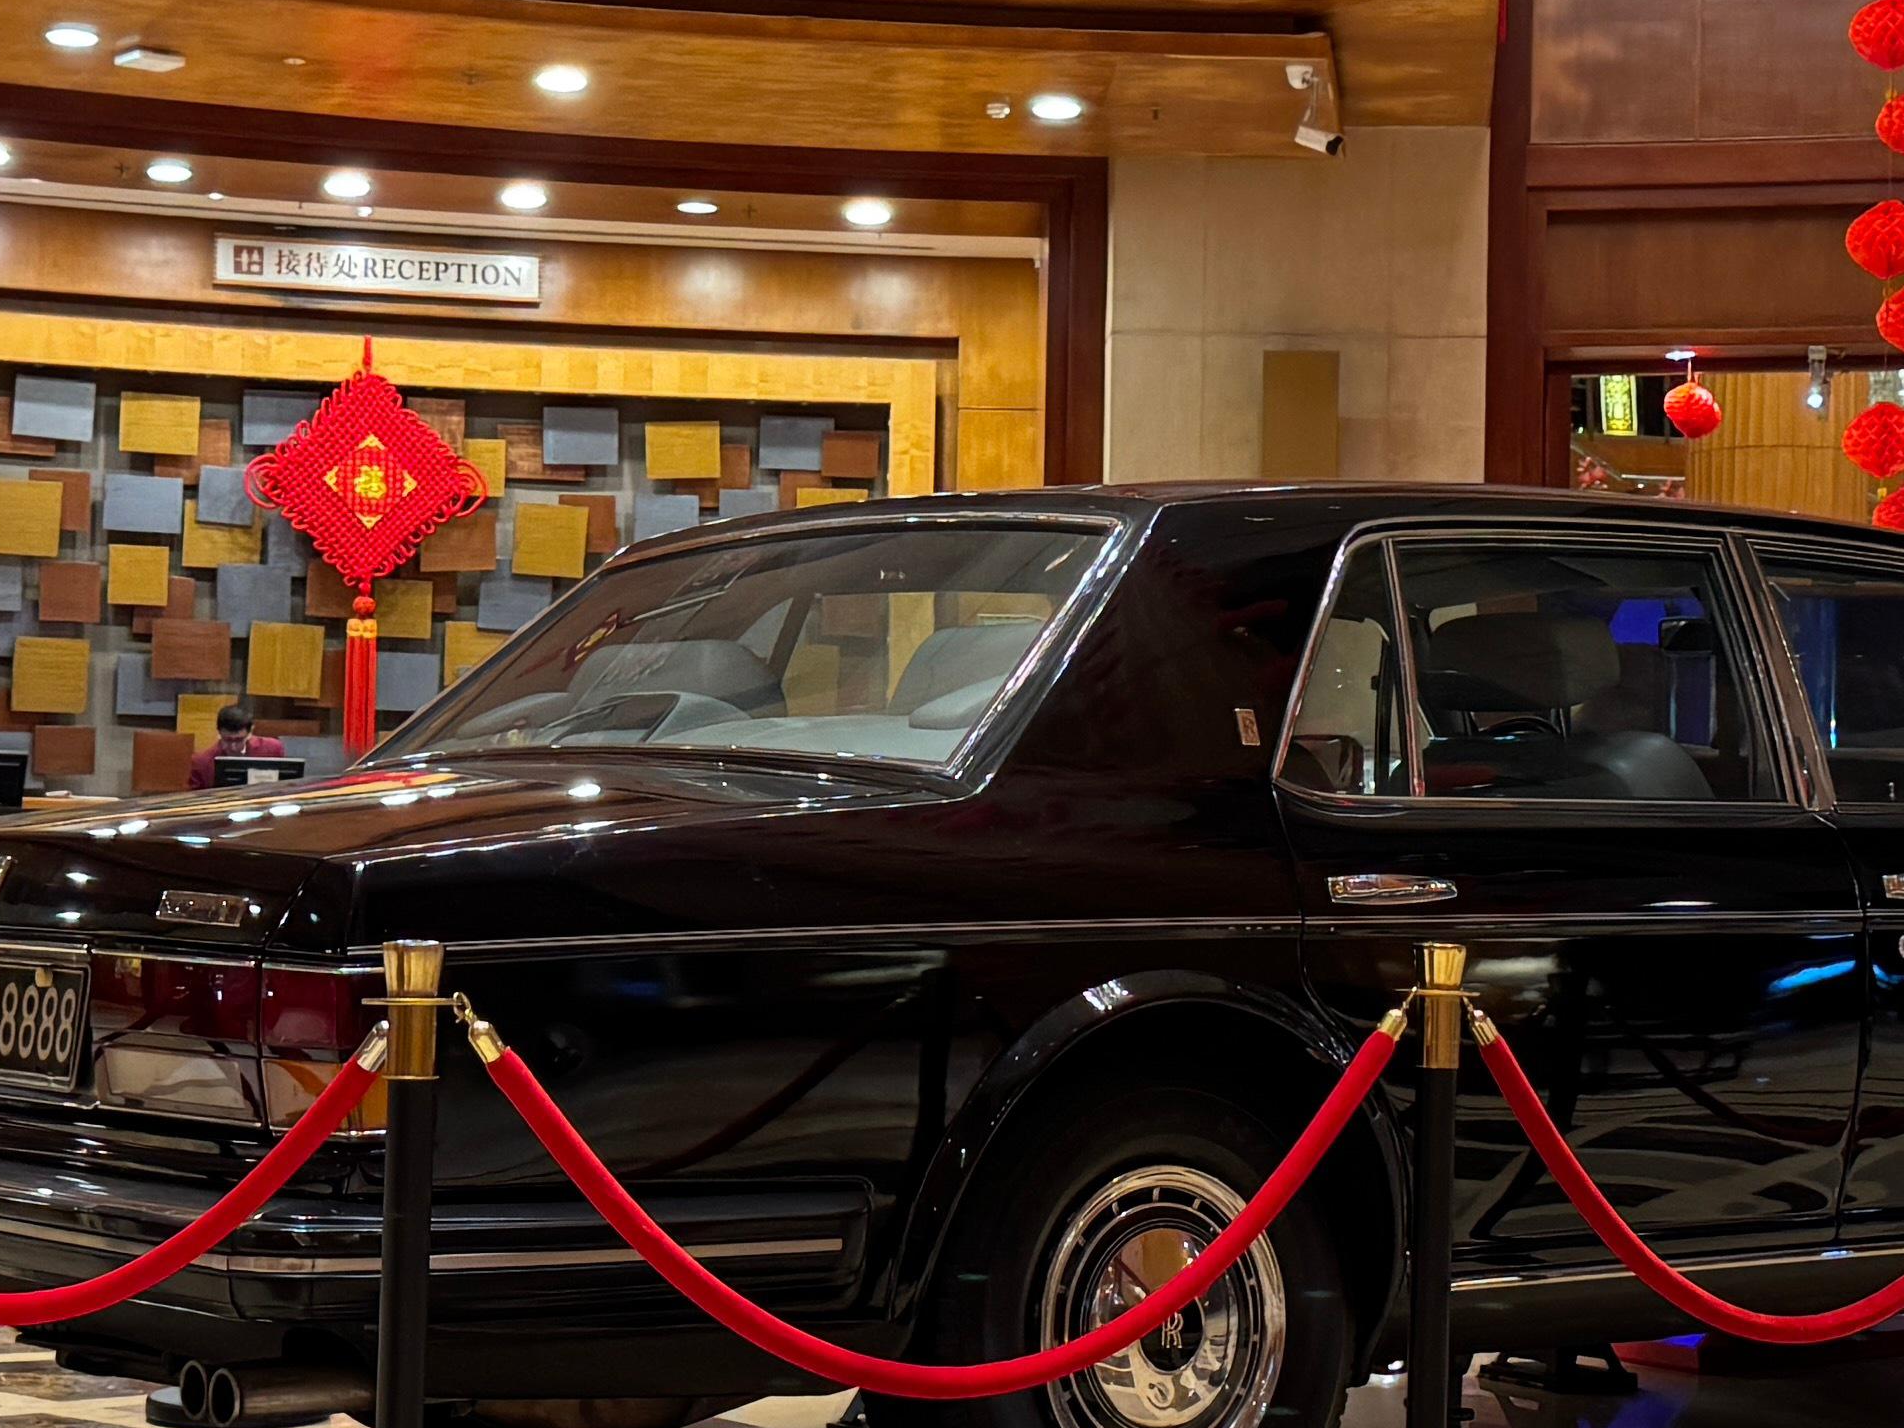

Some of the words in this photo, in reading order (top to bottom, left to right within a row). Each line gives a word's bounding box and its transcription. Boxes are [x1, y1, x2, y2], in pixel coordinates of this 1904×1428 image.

[274, 249, 358, 280] 接待处
[364, 257, 523, 287] RECEPTION
